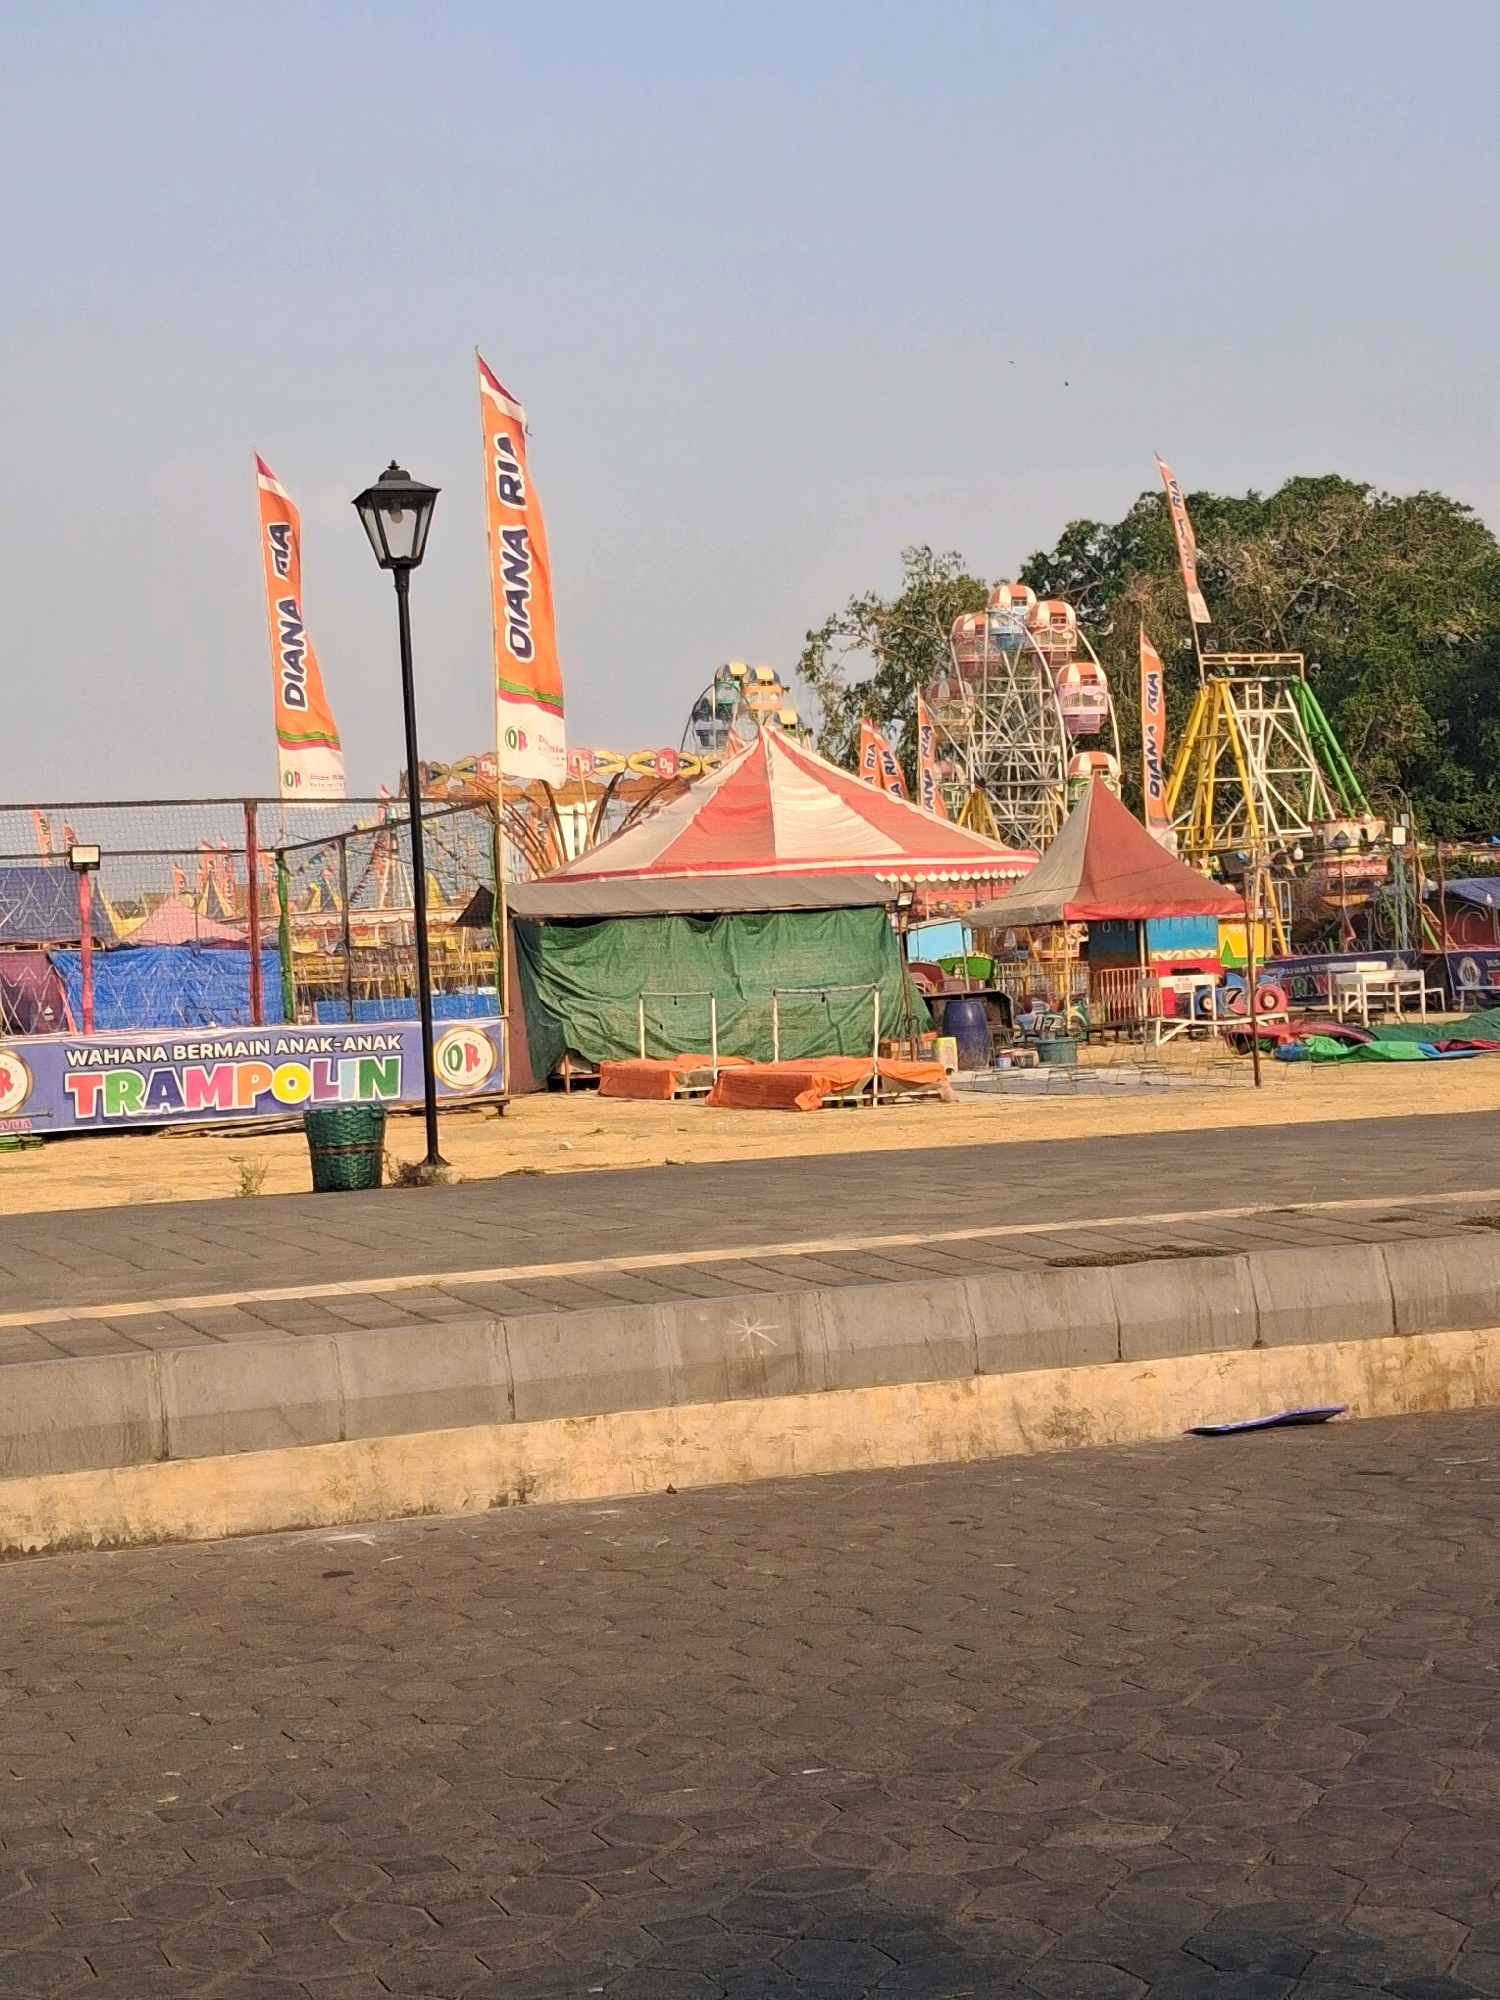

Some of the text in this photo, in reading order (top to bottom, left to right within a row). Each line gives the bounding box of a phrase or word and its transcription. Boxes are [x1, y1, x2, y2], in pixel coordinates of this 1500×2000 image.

[494, 432, 533, 662] DIANA RIA
[276, 596, 308, 712] DIANA
[660, 757, 674, 774] DR
[866, 743, 876, 769] RIA
[881, 750, 898, 776] RIA
[1226, 987, 1242, 1005] 7
[66, 1032, 404, 1068] WAHANA BERMAIN ANAK-ANAK
[66, 1057, 402, 1118] TRAMPOLIN
